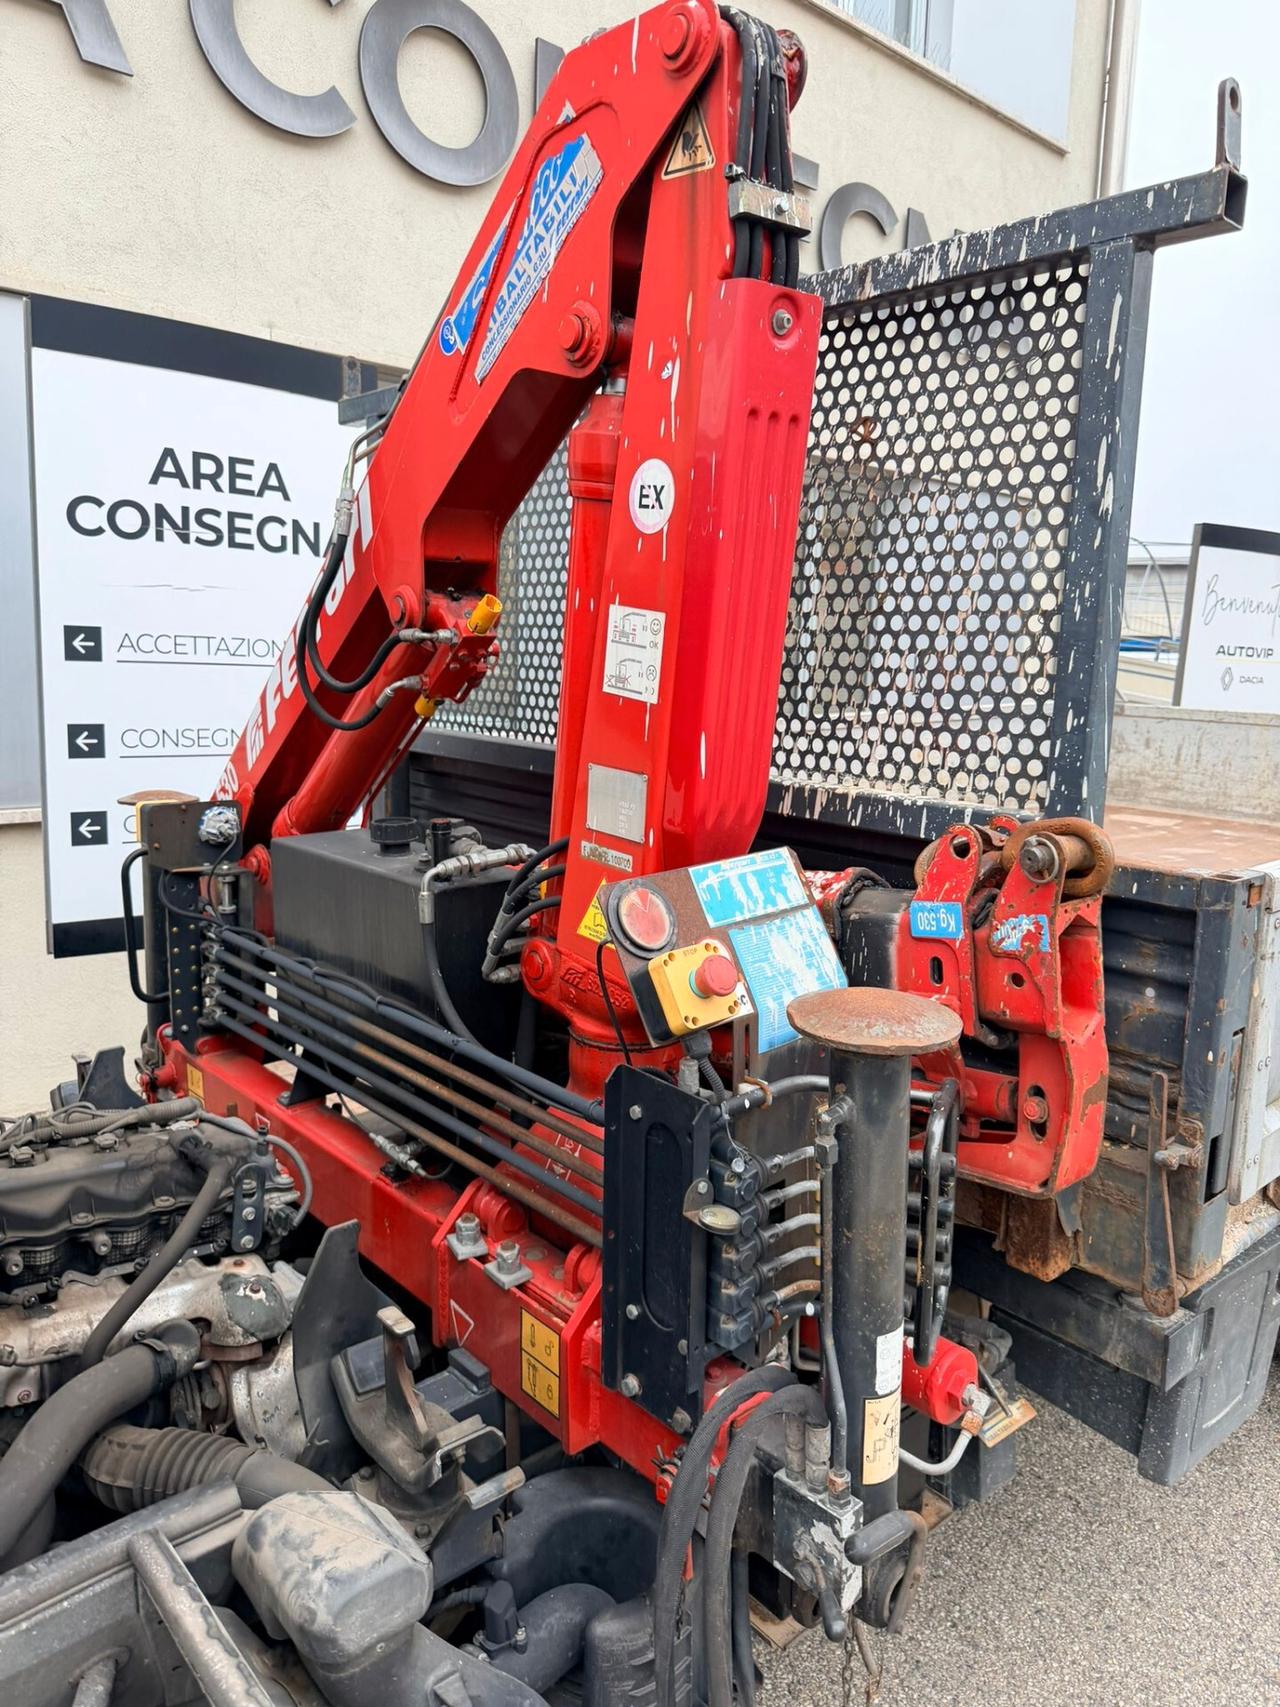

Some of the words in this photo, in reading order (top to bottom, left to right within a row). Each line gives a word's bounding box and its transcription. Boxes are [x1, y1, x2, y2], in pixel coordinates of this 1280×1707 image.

[488, 171, 577, 333] IBALTABILI
[481, 274, 532, 361] CONCESSIONARIO
[148, 447, 291, 502] AREA
[639, 485, 665, 509] EX
[66, 495, 334, 558] CONSEGN
[1216, 644, 1275, 659] AUTOVIP
[1240, 675, 1264, 685] DACIA
[917, 908, 957, 932] Kg.530
